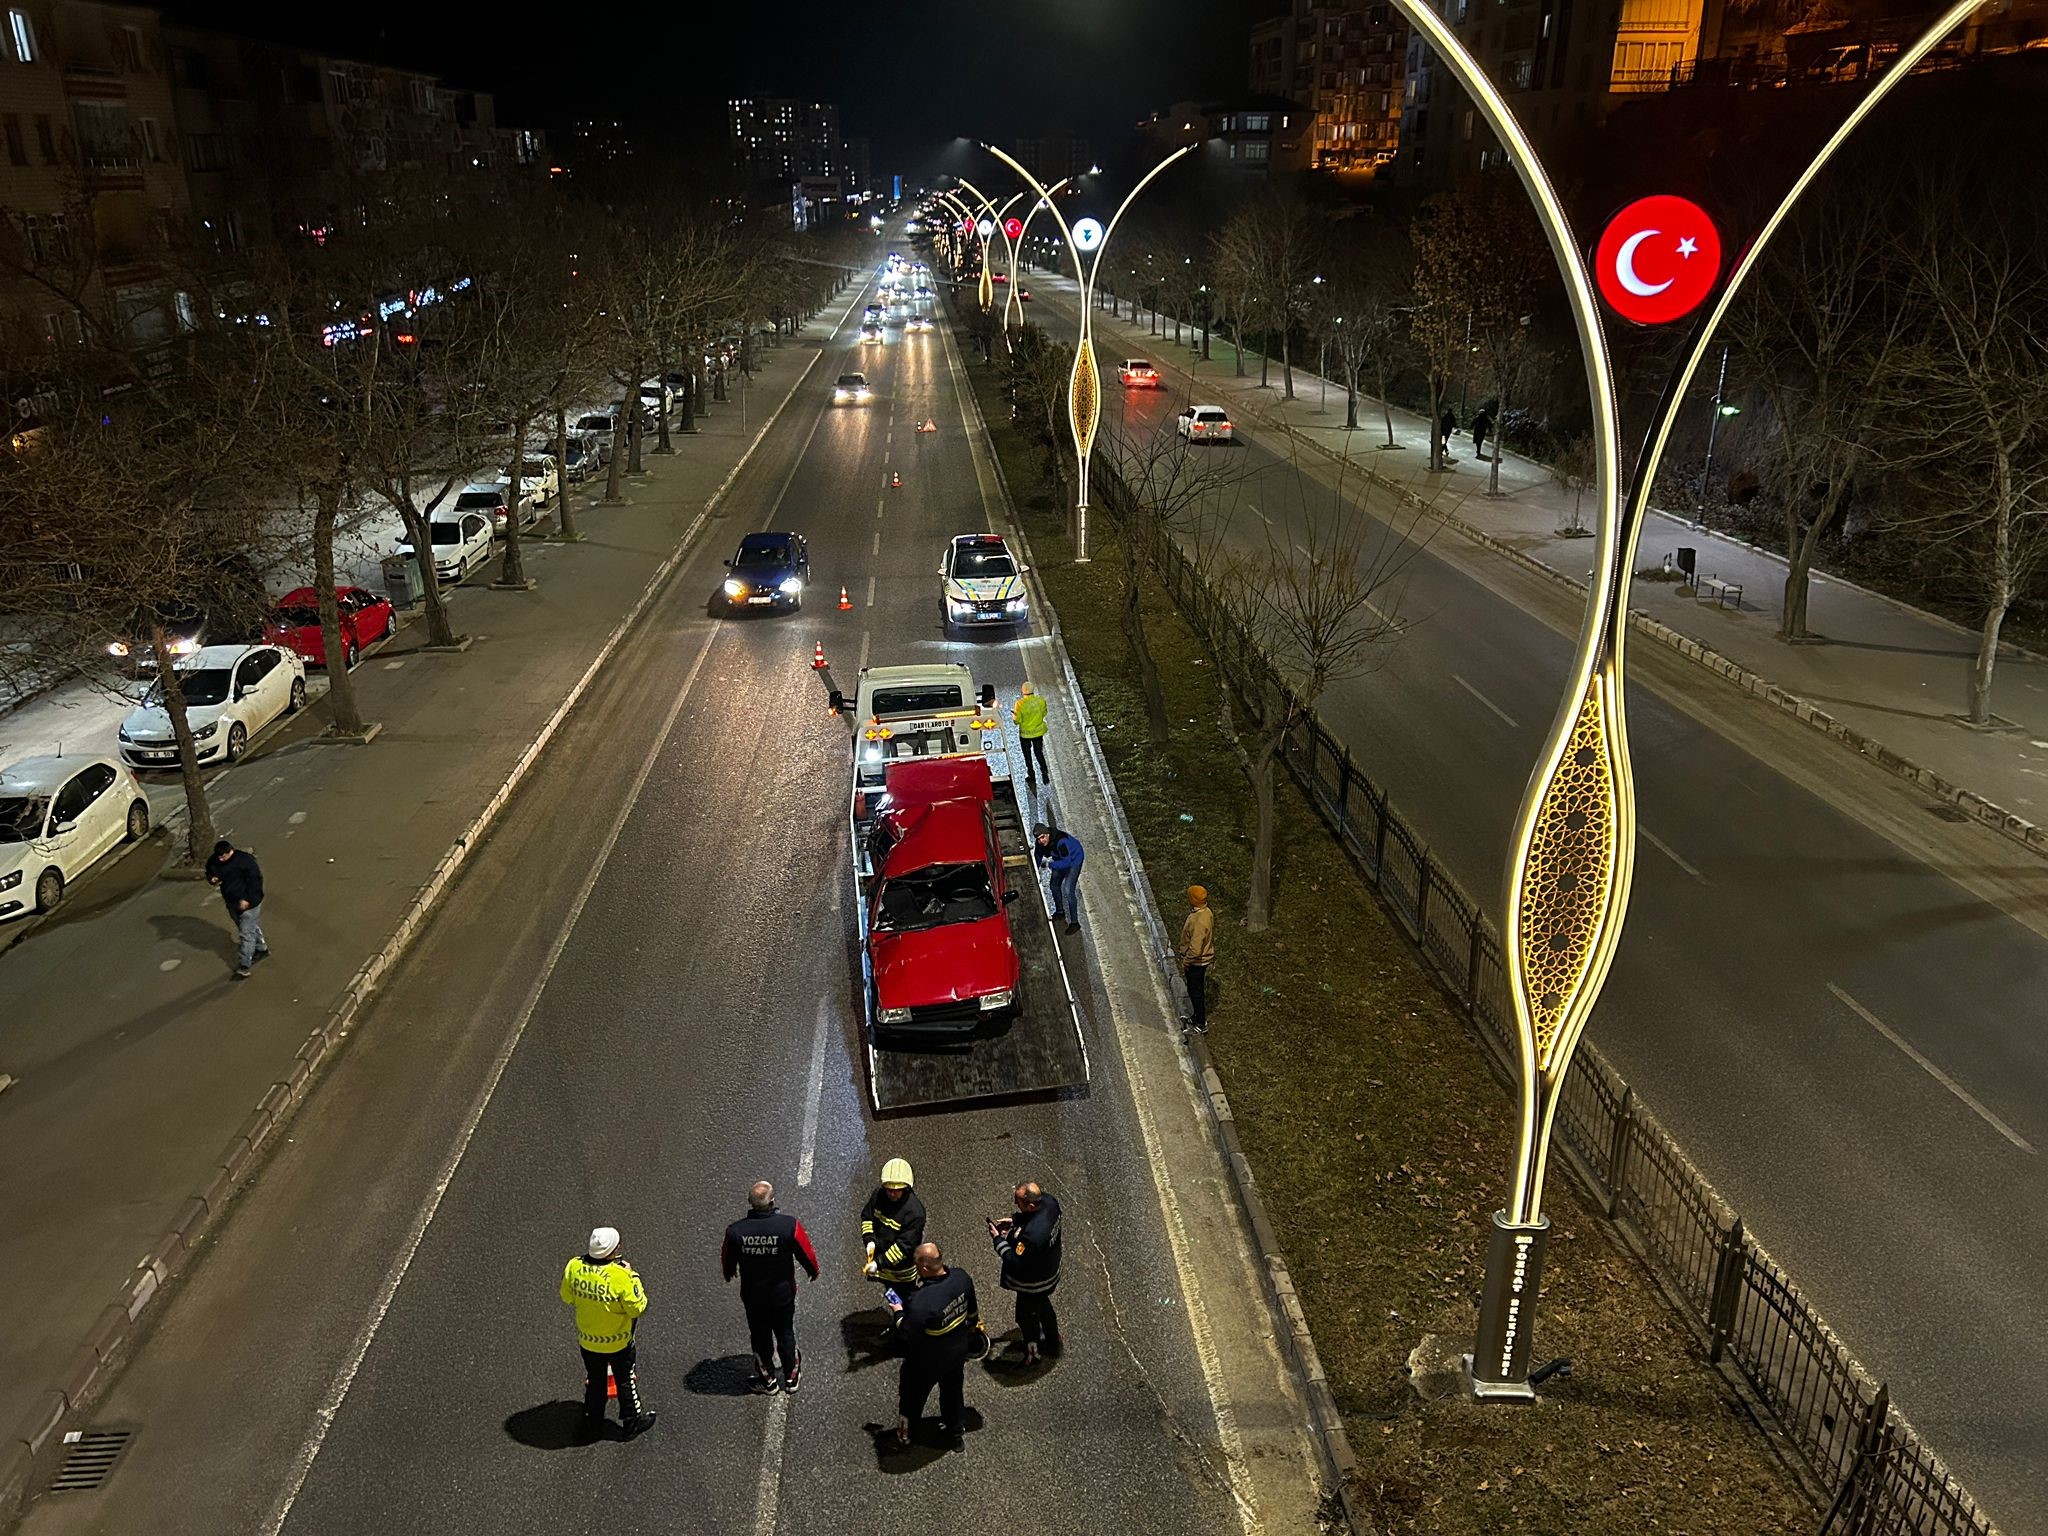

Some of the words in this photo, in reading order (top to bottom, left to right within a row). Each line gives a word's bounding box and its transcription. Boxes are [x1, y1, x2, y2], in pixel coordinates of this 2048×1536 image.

[741, 1235, 779, 1246] YOZGAT
[1512, 1244, 1528, 1293] YOZGAT
[573, 1277, 611, 1296] POLİSİ
